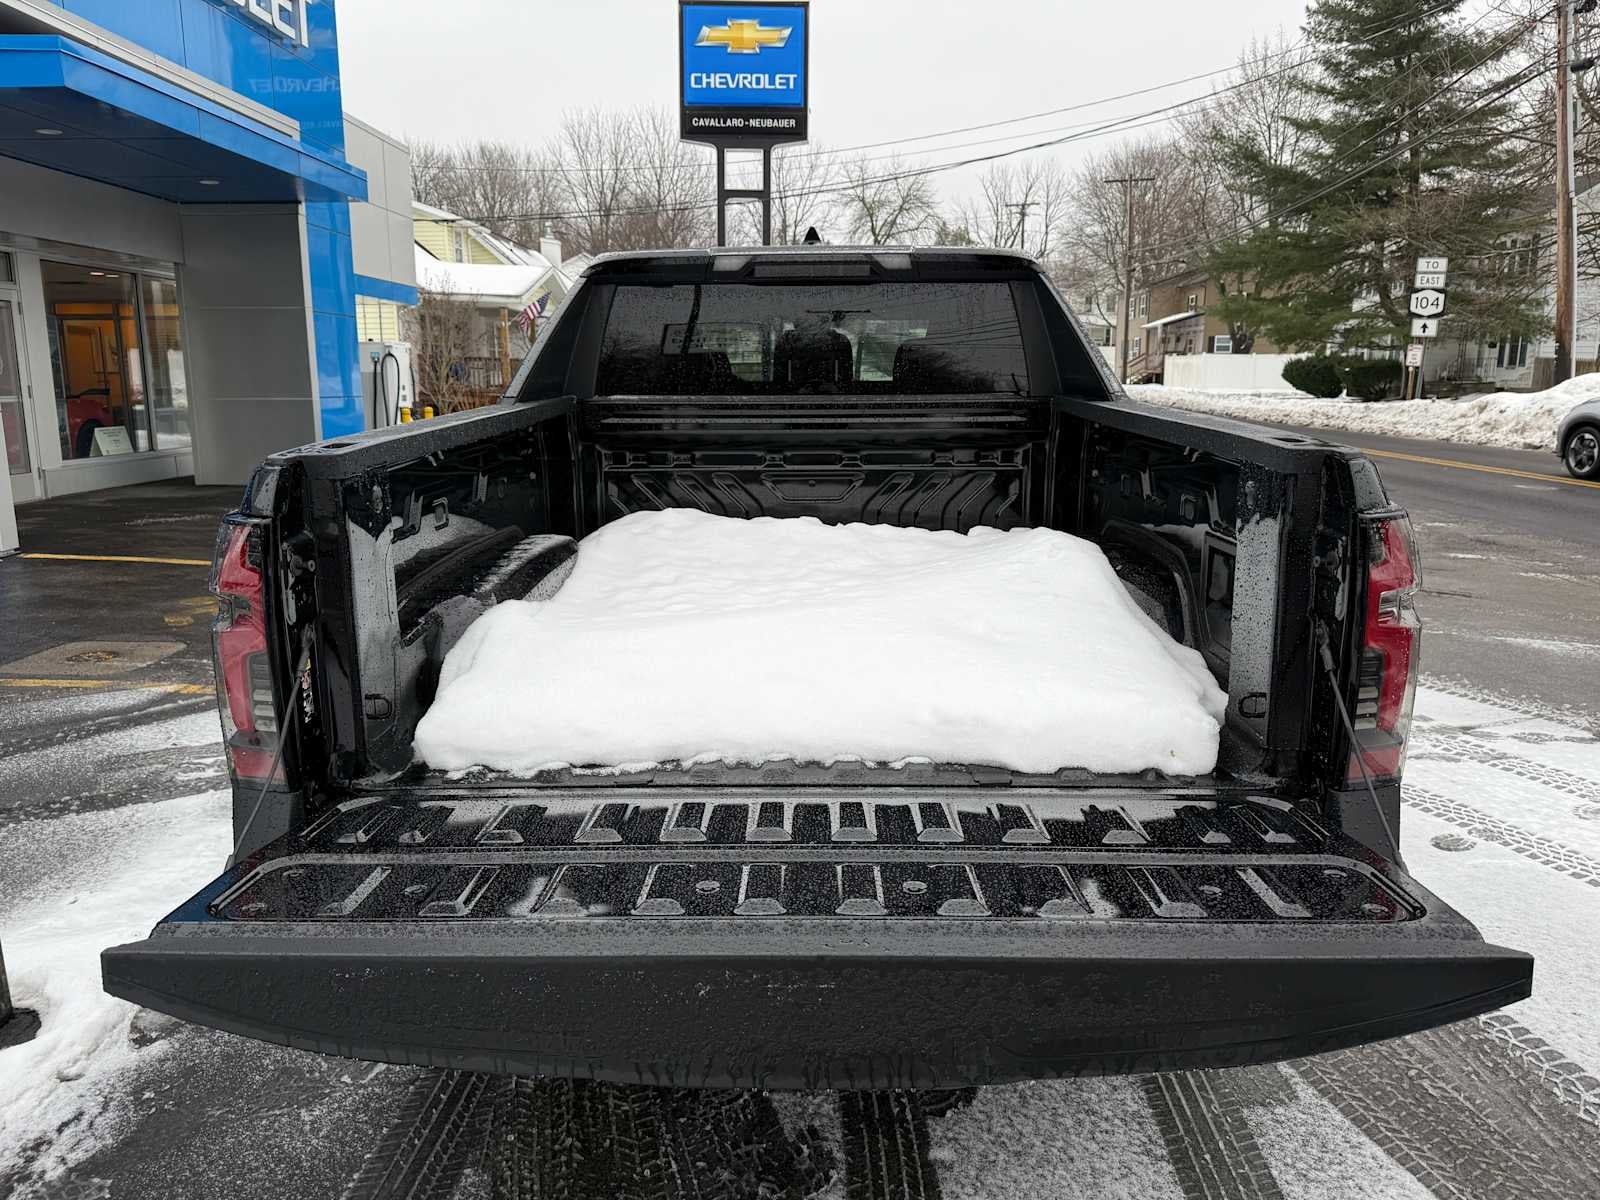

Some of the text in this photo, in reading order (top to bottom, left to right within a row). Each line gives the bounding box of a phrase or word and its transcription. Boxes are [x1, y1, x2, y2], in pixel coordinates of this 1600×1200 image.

[233, 0, 312, 48] LET
[690, 72, 797, 89] CHEVROLET
[692, 117, 796, 128] CAVALLARO-NEUBAUER
[1425, 261, 1439, 269] TO
[1420, 276, 1440, 285] EAST
[1415, 296, 1440, 310] 104
